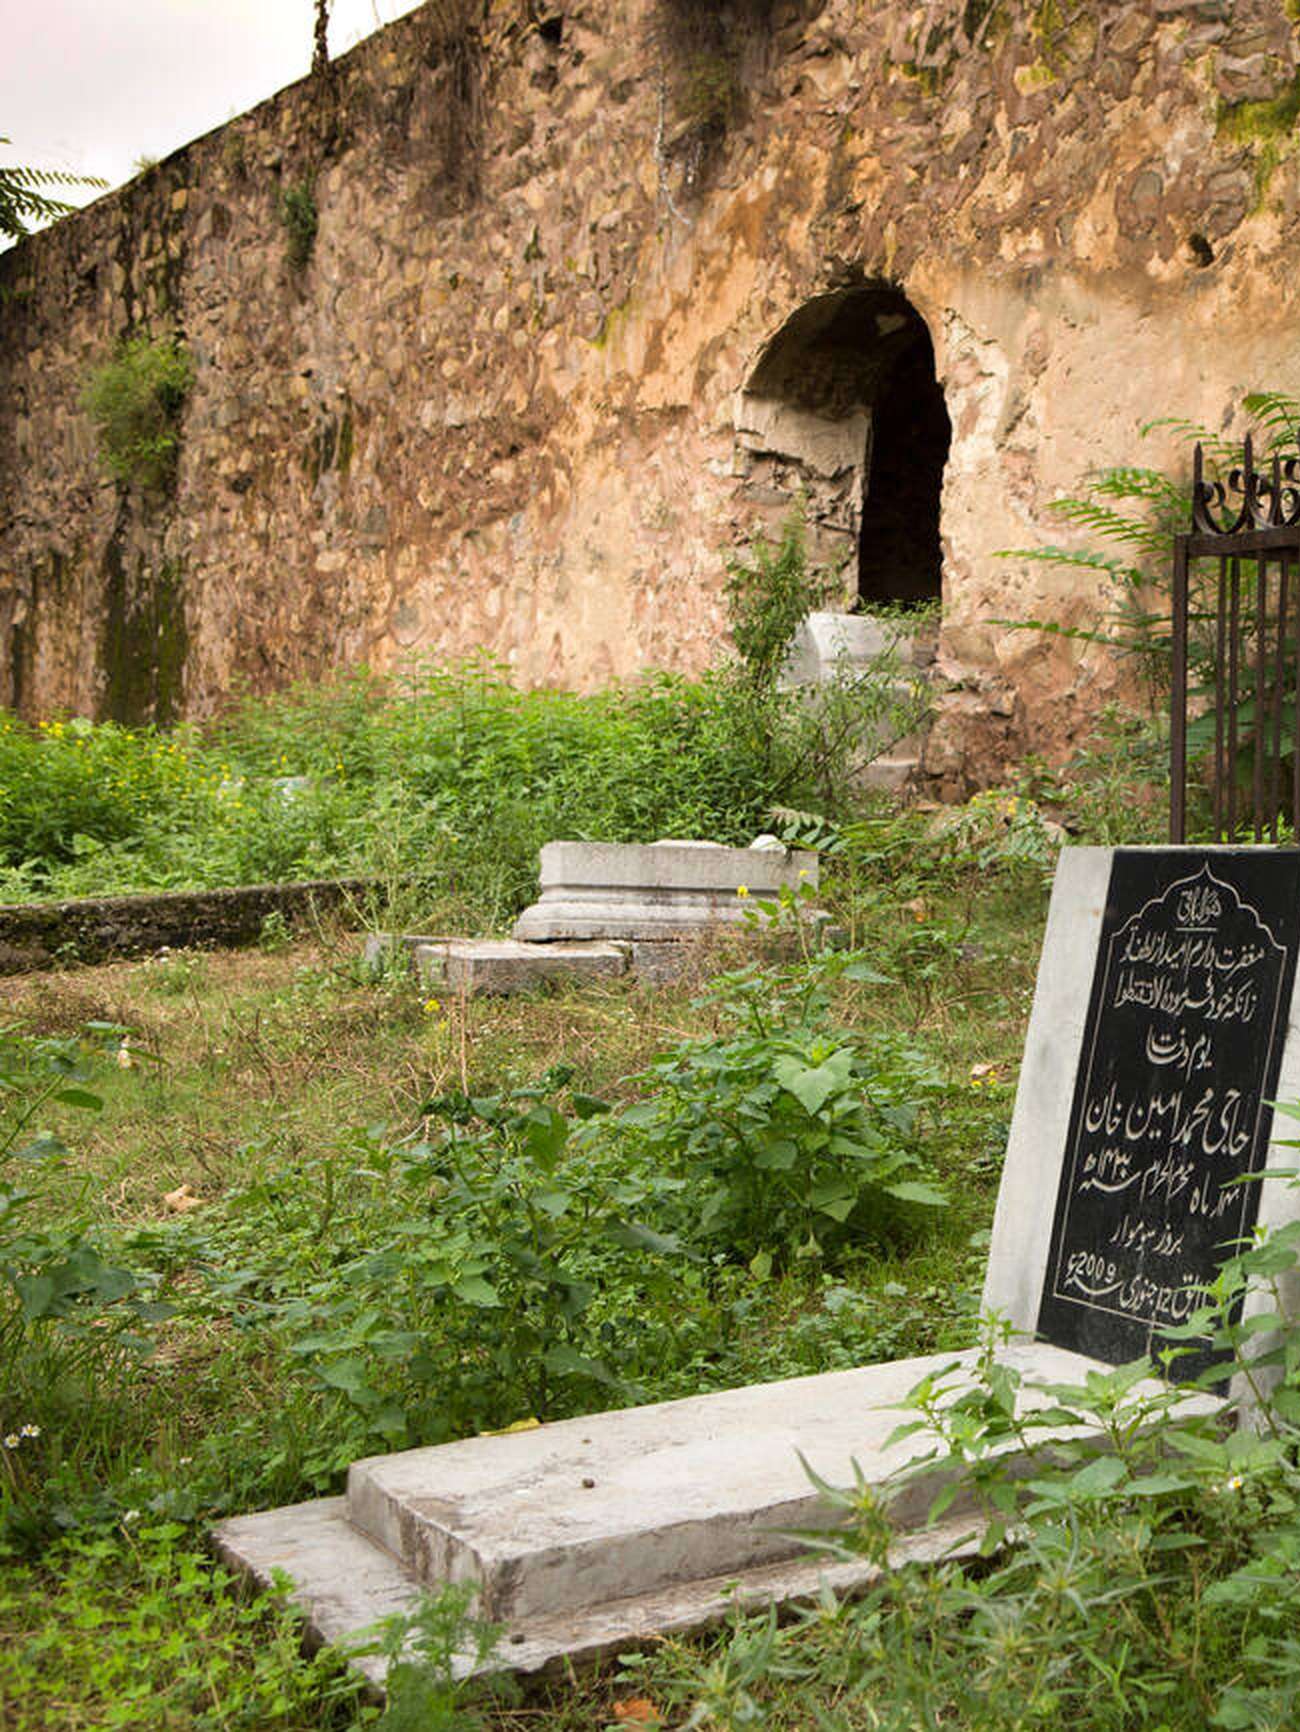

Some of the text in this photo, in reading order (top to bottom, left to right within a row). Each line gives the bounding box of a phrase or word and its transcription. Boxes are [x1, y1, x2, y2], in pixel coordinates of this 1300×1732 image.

[1085, 1080, 1250, 1156] حاجی محمد امین خان
